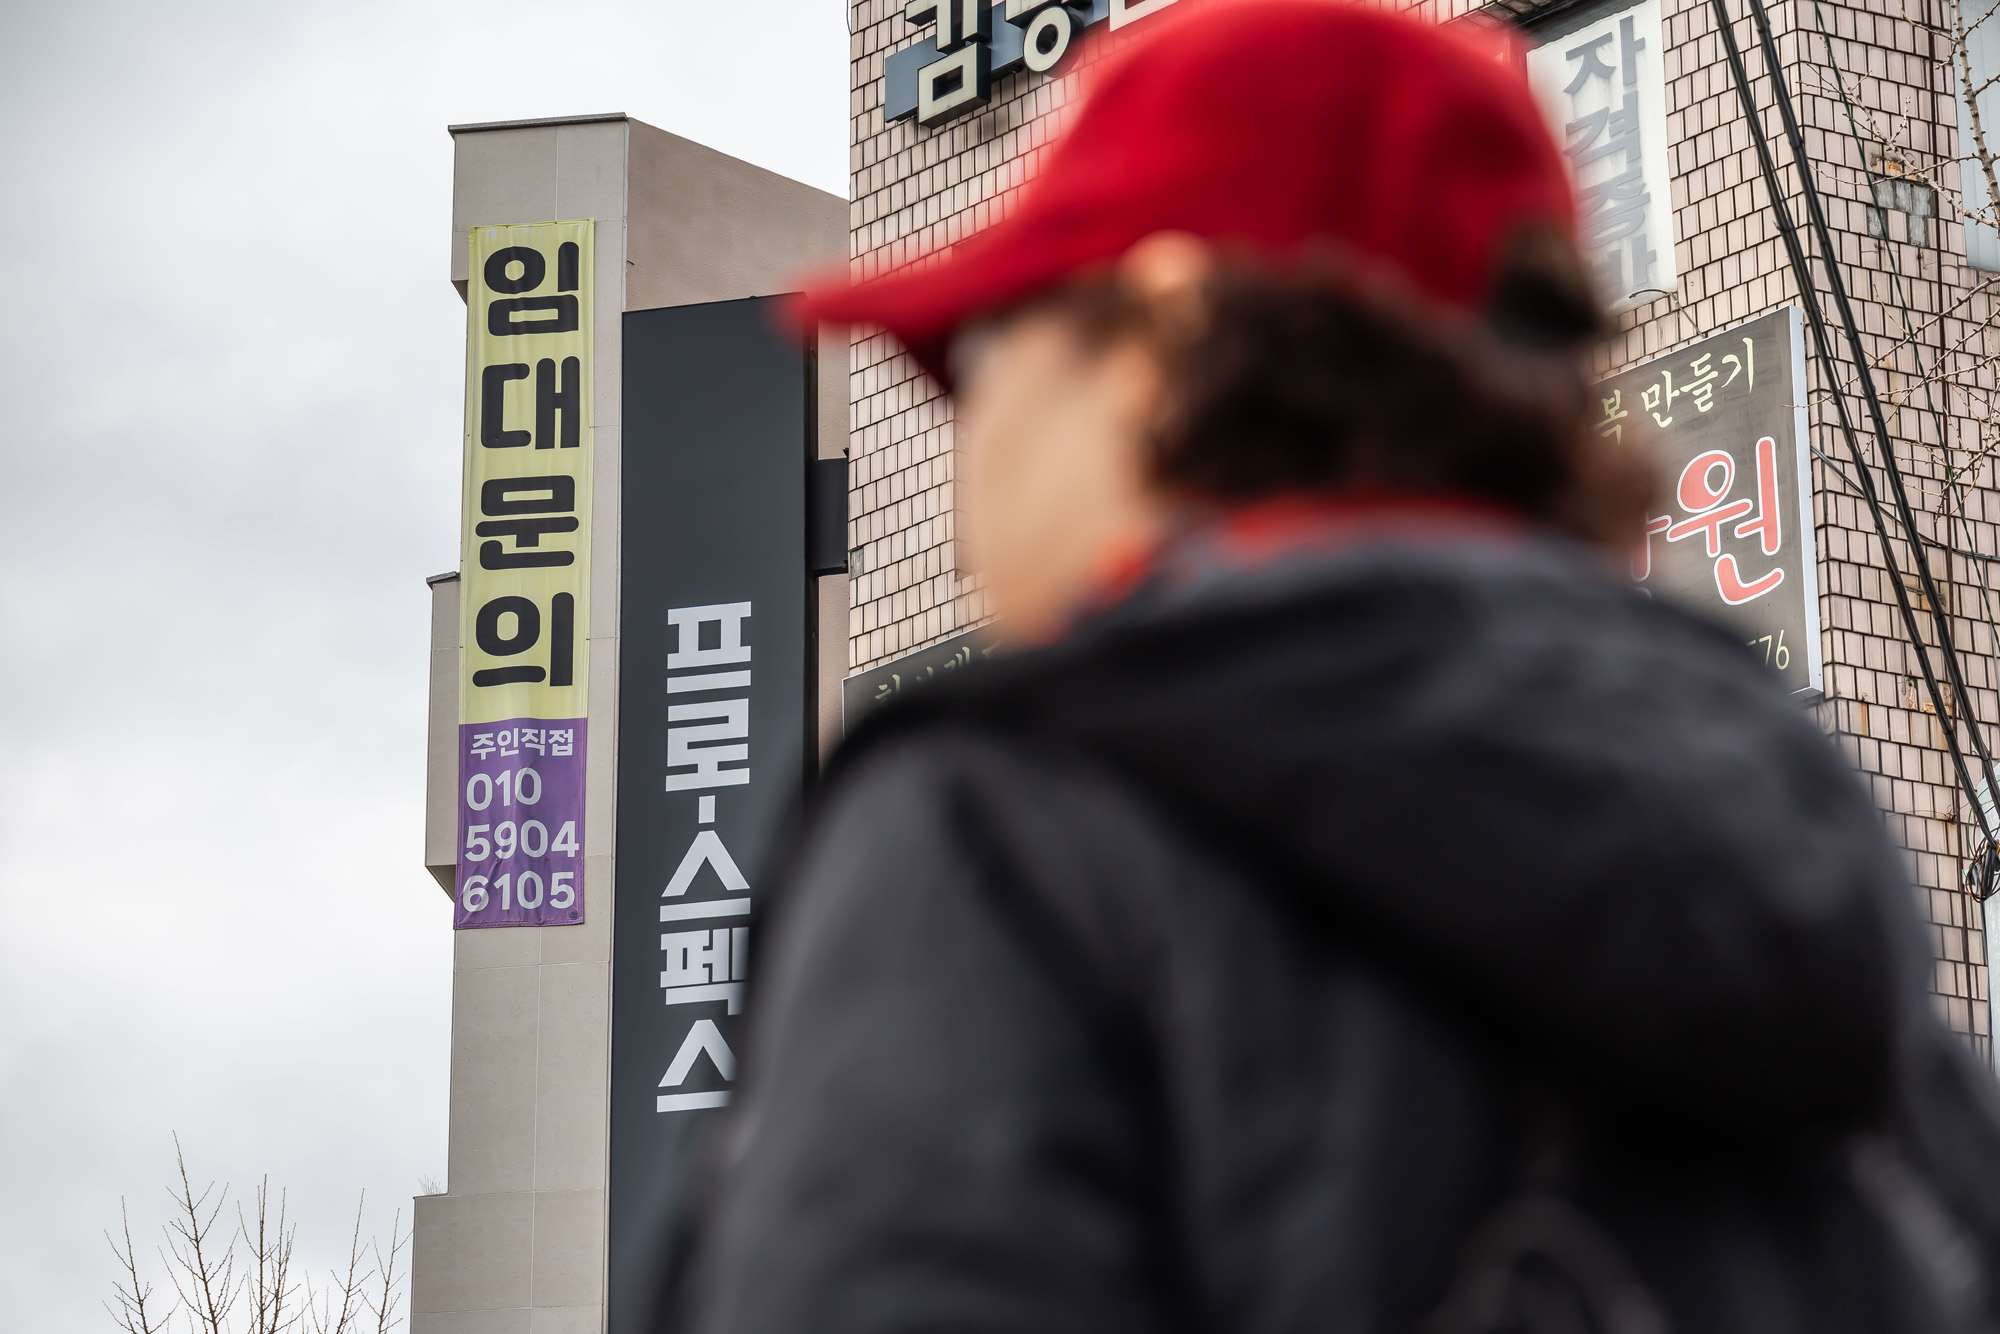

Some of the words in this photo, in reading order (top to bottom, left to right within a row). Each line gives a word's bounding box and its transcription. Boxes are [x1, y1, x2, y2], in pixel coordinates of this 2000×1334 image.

[1641, 337, 1754, 428] 만들기
[472, 241, 580, 687] 임대문의
[1745, 628, 1790, 670] 76
[470, 728, 574, 760] 주인직접
[466, 767, 542, 811] 010
[465, 819, 579, 862] 5904
[462, 871, 575, 912] 6105
